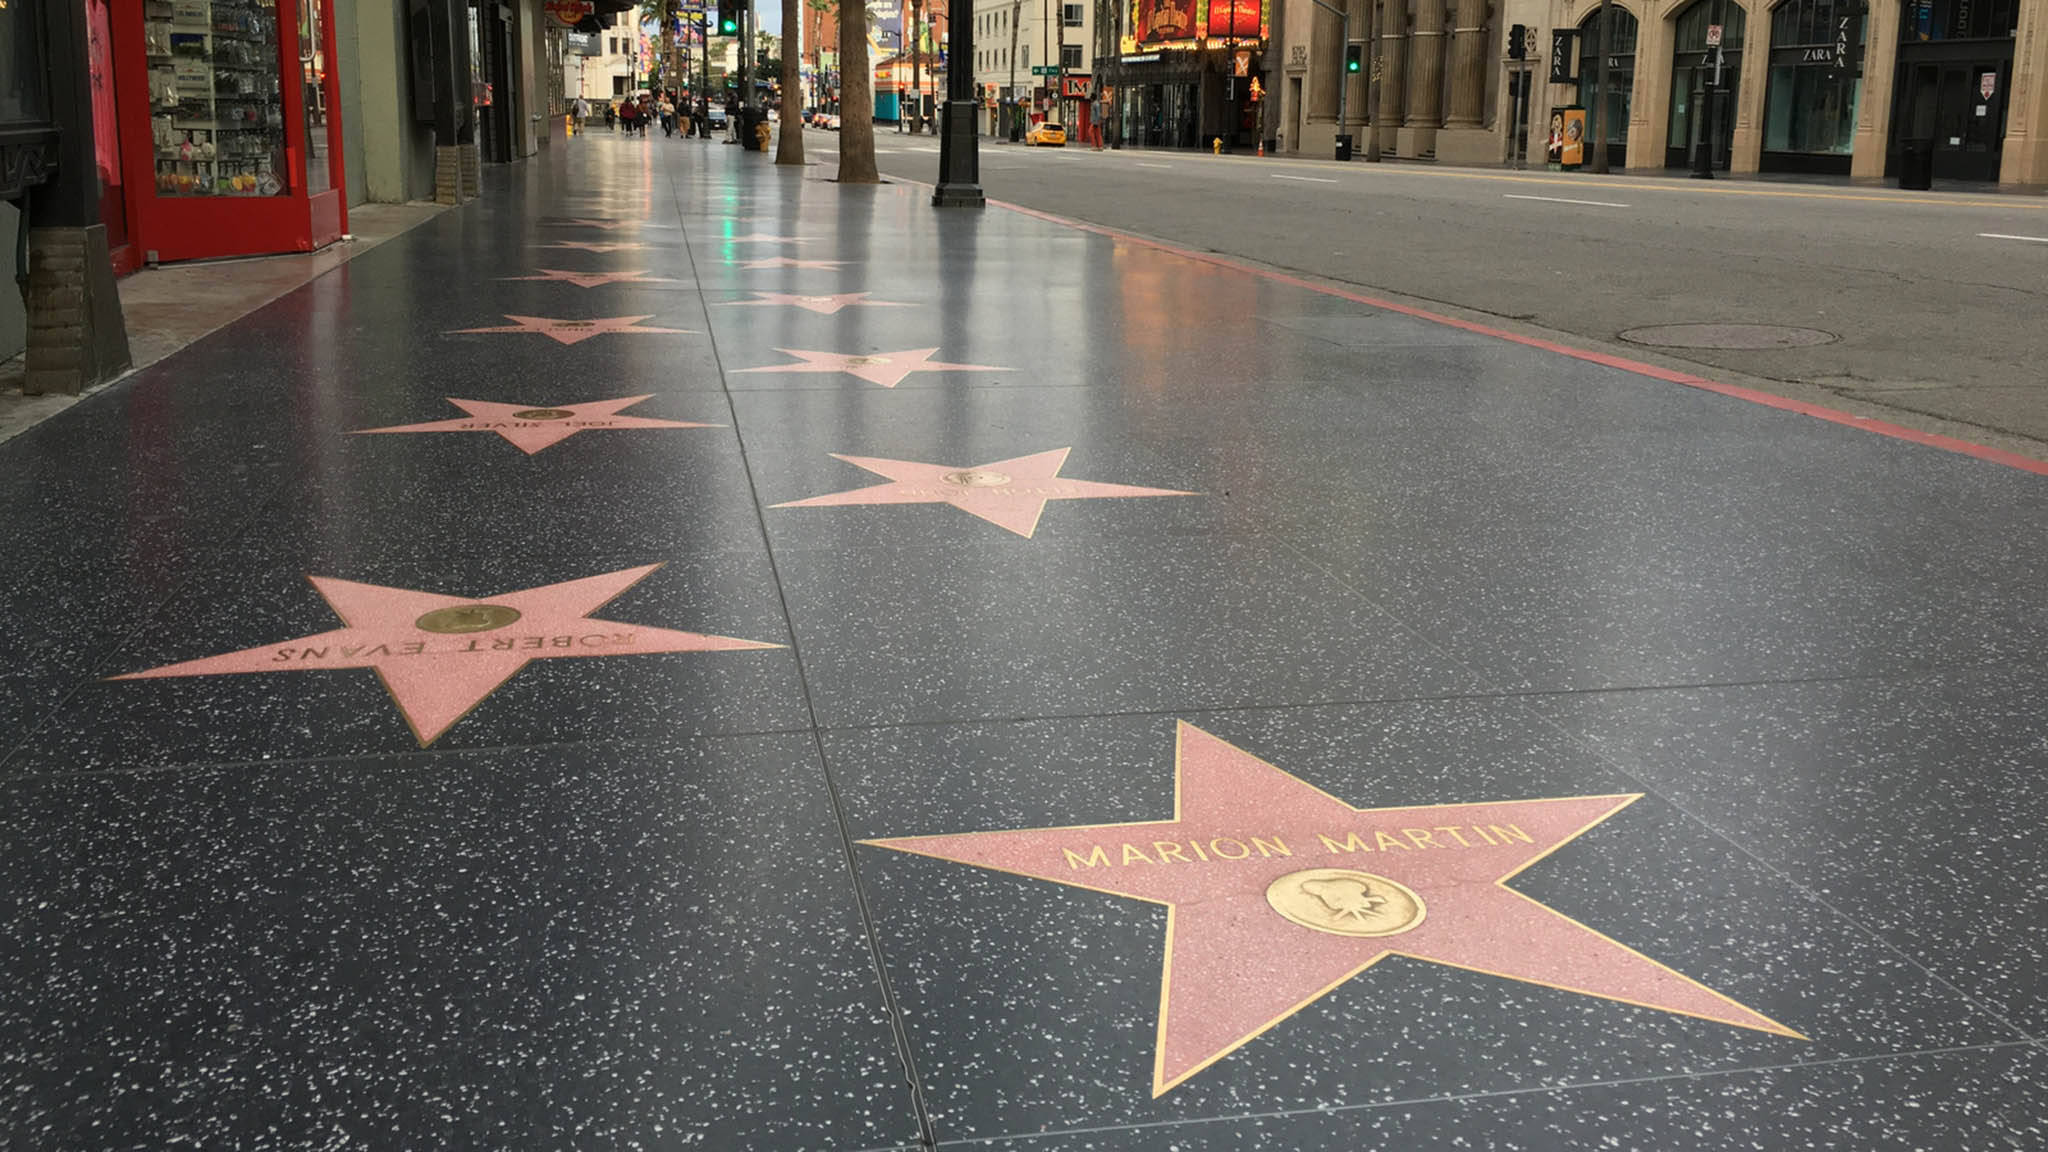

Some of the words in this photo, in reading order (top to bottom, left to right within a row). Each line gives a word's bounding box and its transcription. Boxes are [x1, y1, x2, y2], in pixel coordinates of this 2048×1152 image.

[1553, 36, 1563, 76] ZARA
[1802, 48, 1832, 61] ZARA
[1833, 16, 1849, 68] ZARA
[272, 641, 426, 663] EVANS
[457, 632, 636, 653] ROBERT
[1061, 835, 1293, 871] MARION
[1317, 823, 1535, 855] MARTIN
